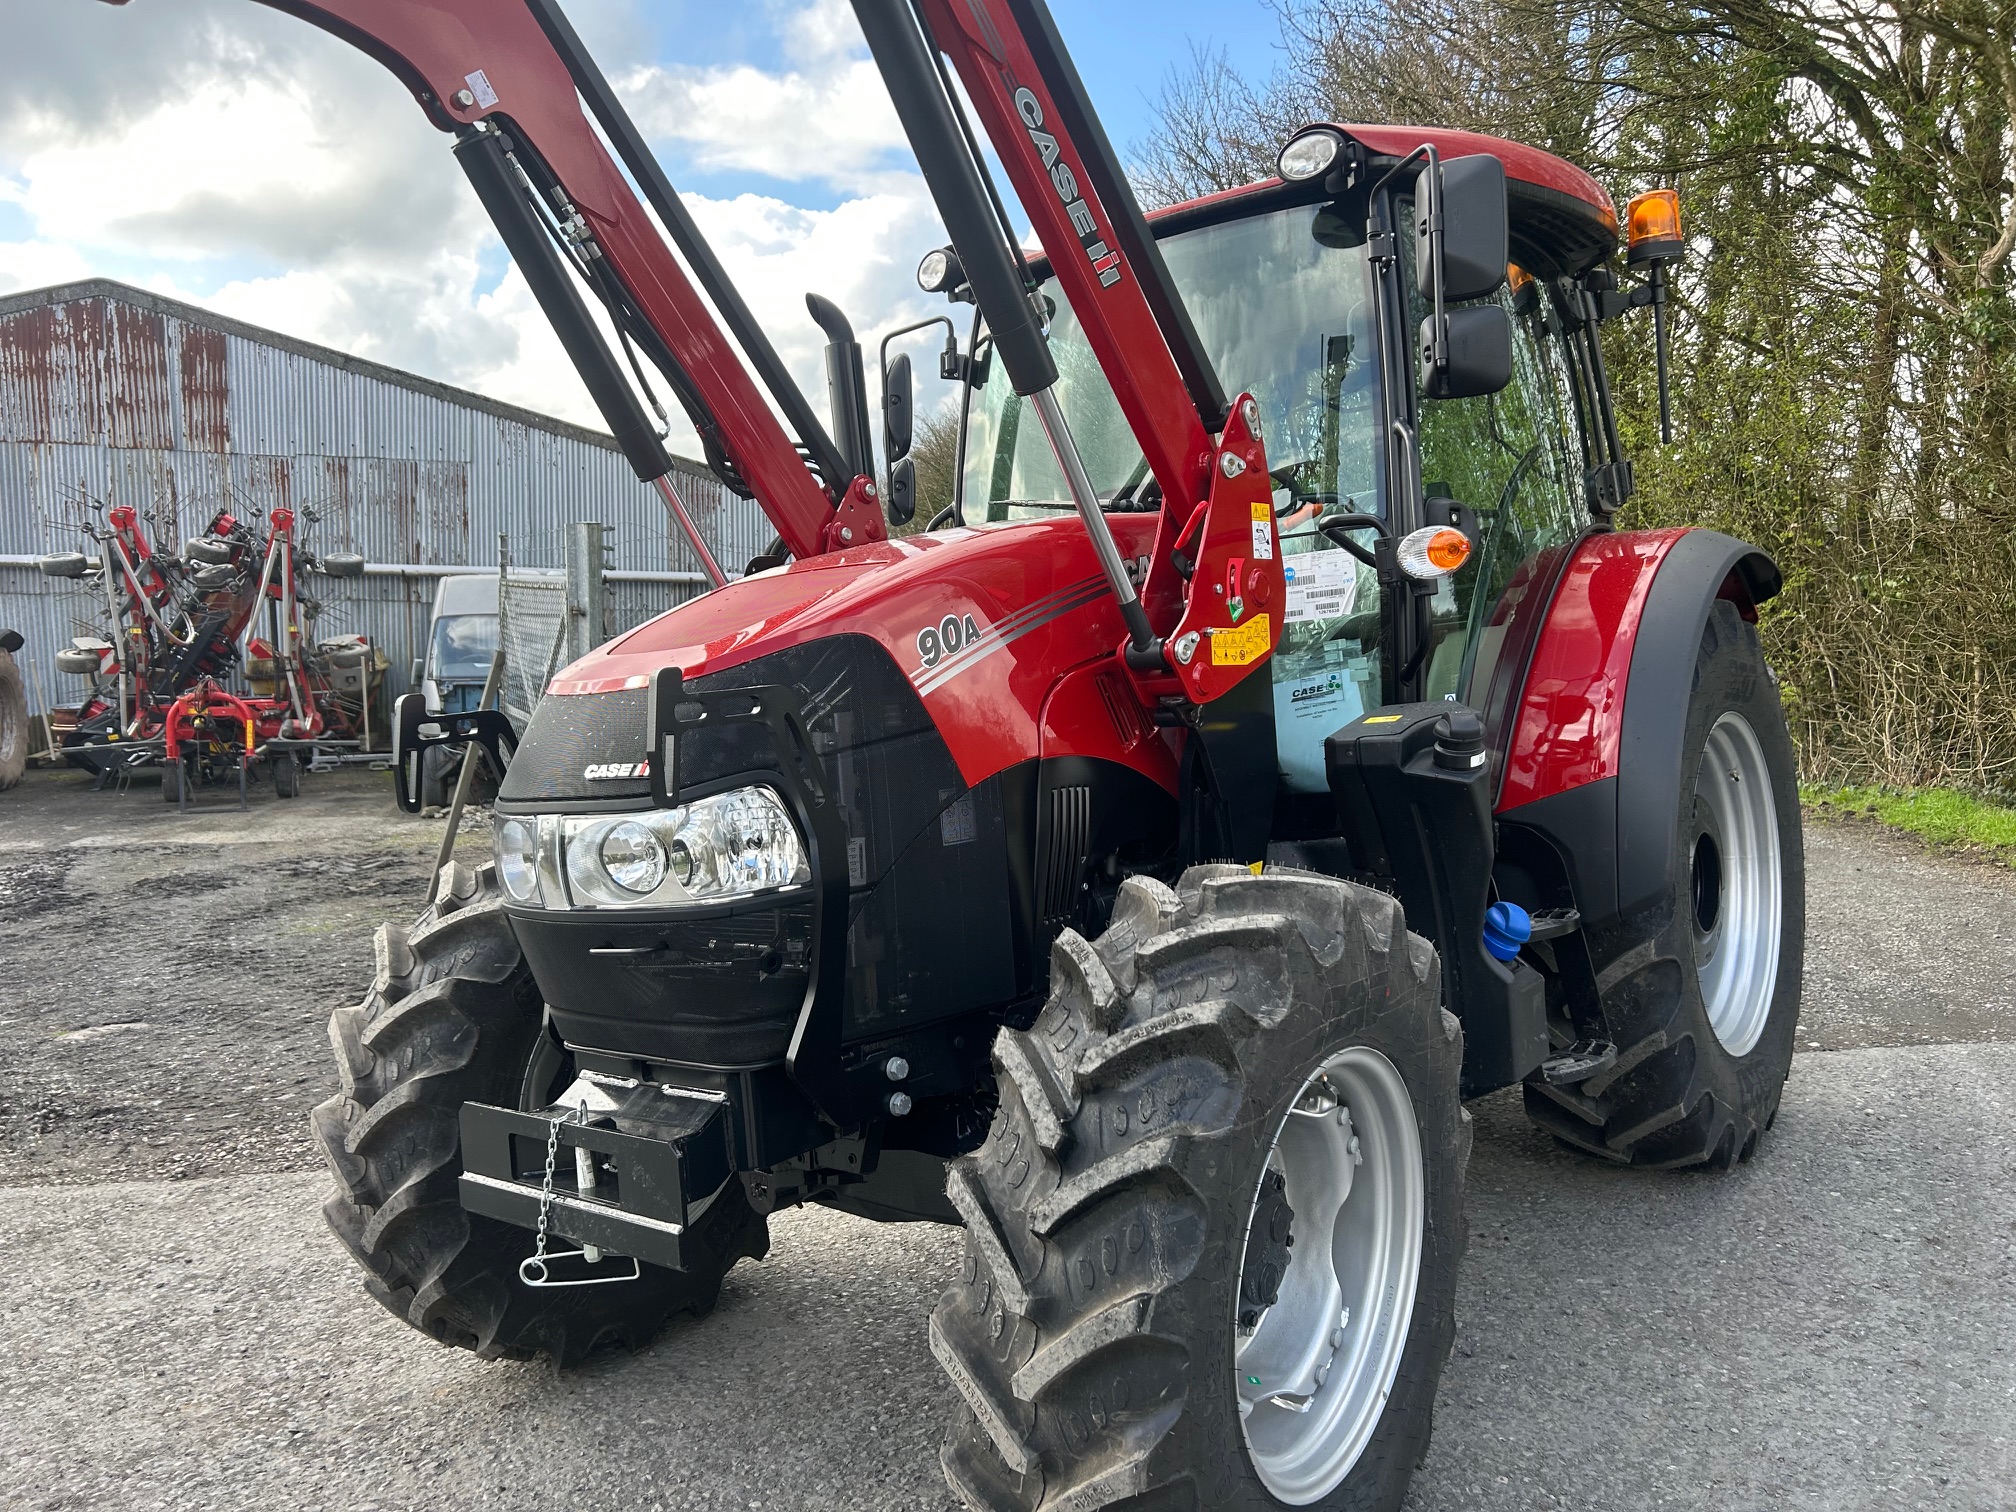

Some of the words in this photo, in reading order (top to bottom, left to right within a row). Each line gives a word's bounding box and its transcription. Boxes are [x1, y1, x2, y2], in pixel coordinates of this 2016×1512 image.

[1014, 86, 1099, 238] CASE
[917, 612, 982, 668] 90A
[1292, 684, 1324, 698] CASE
[584, 763, 634, 779] CASE
